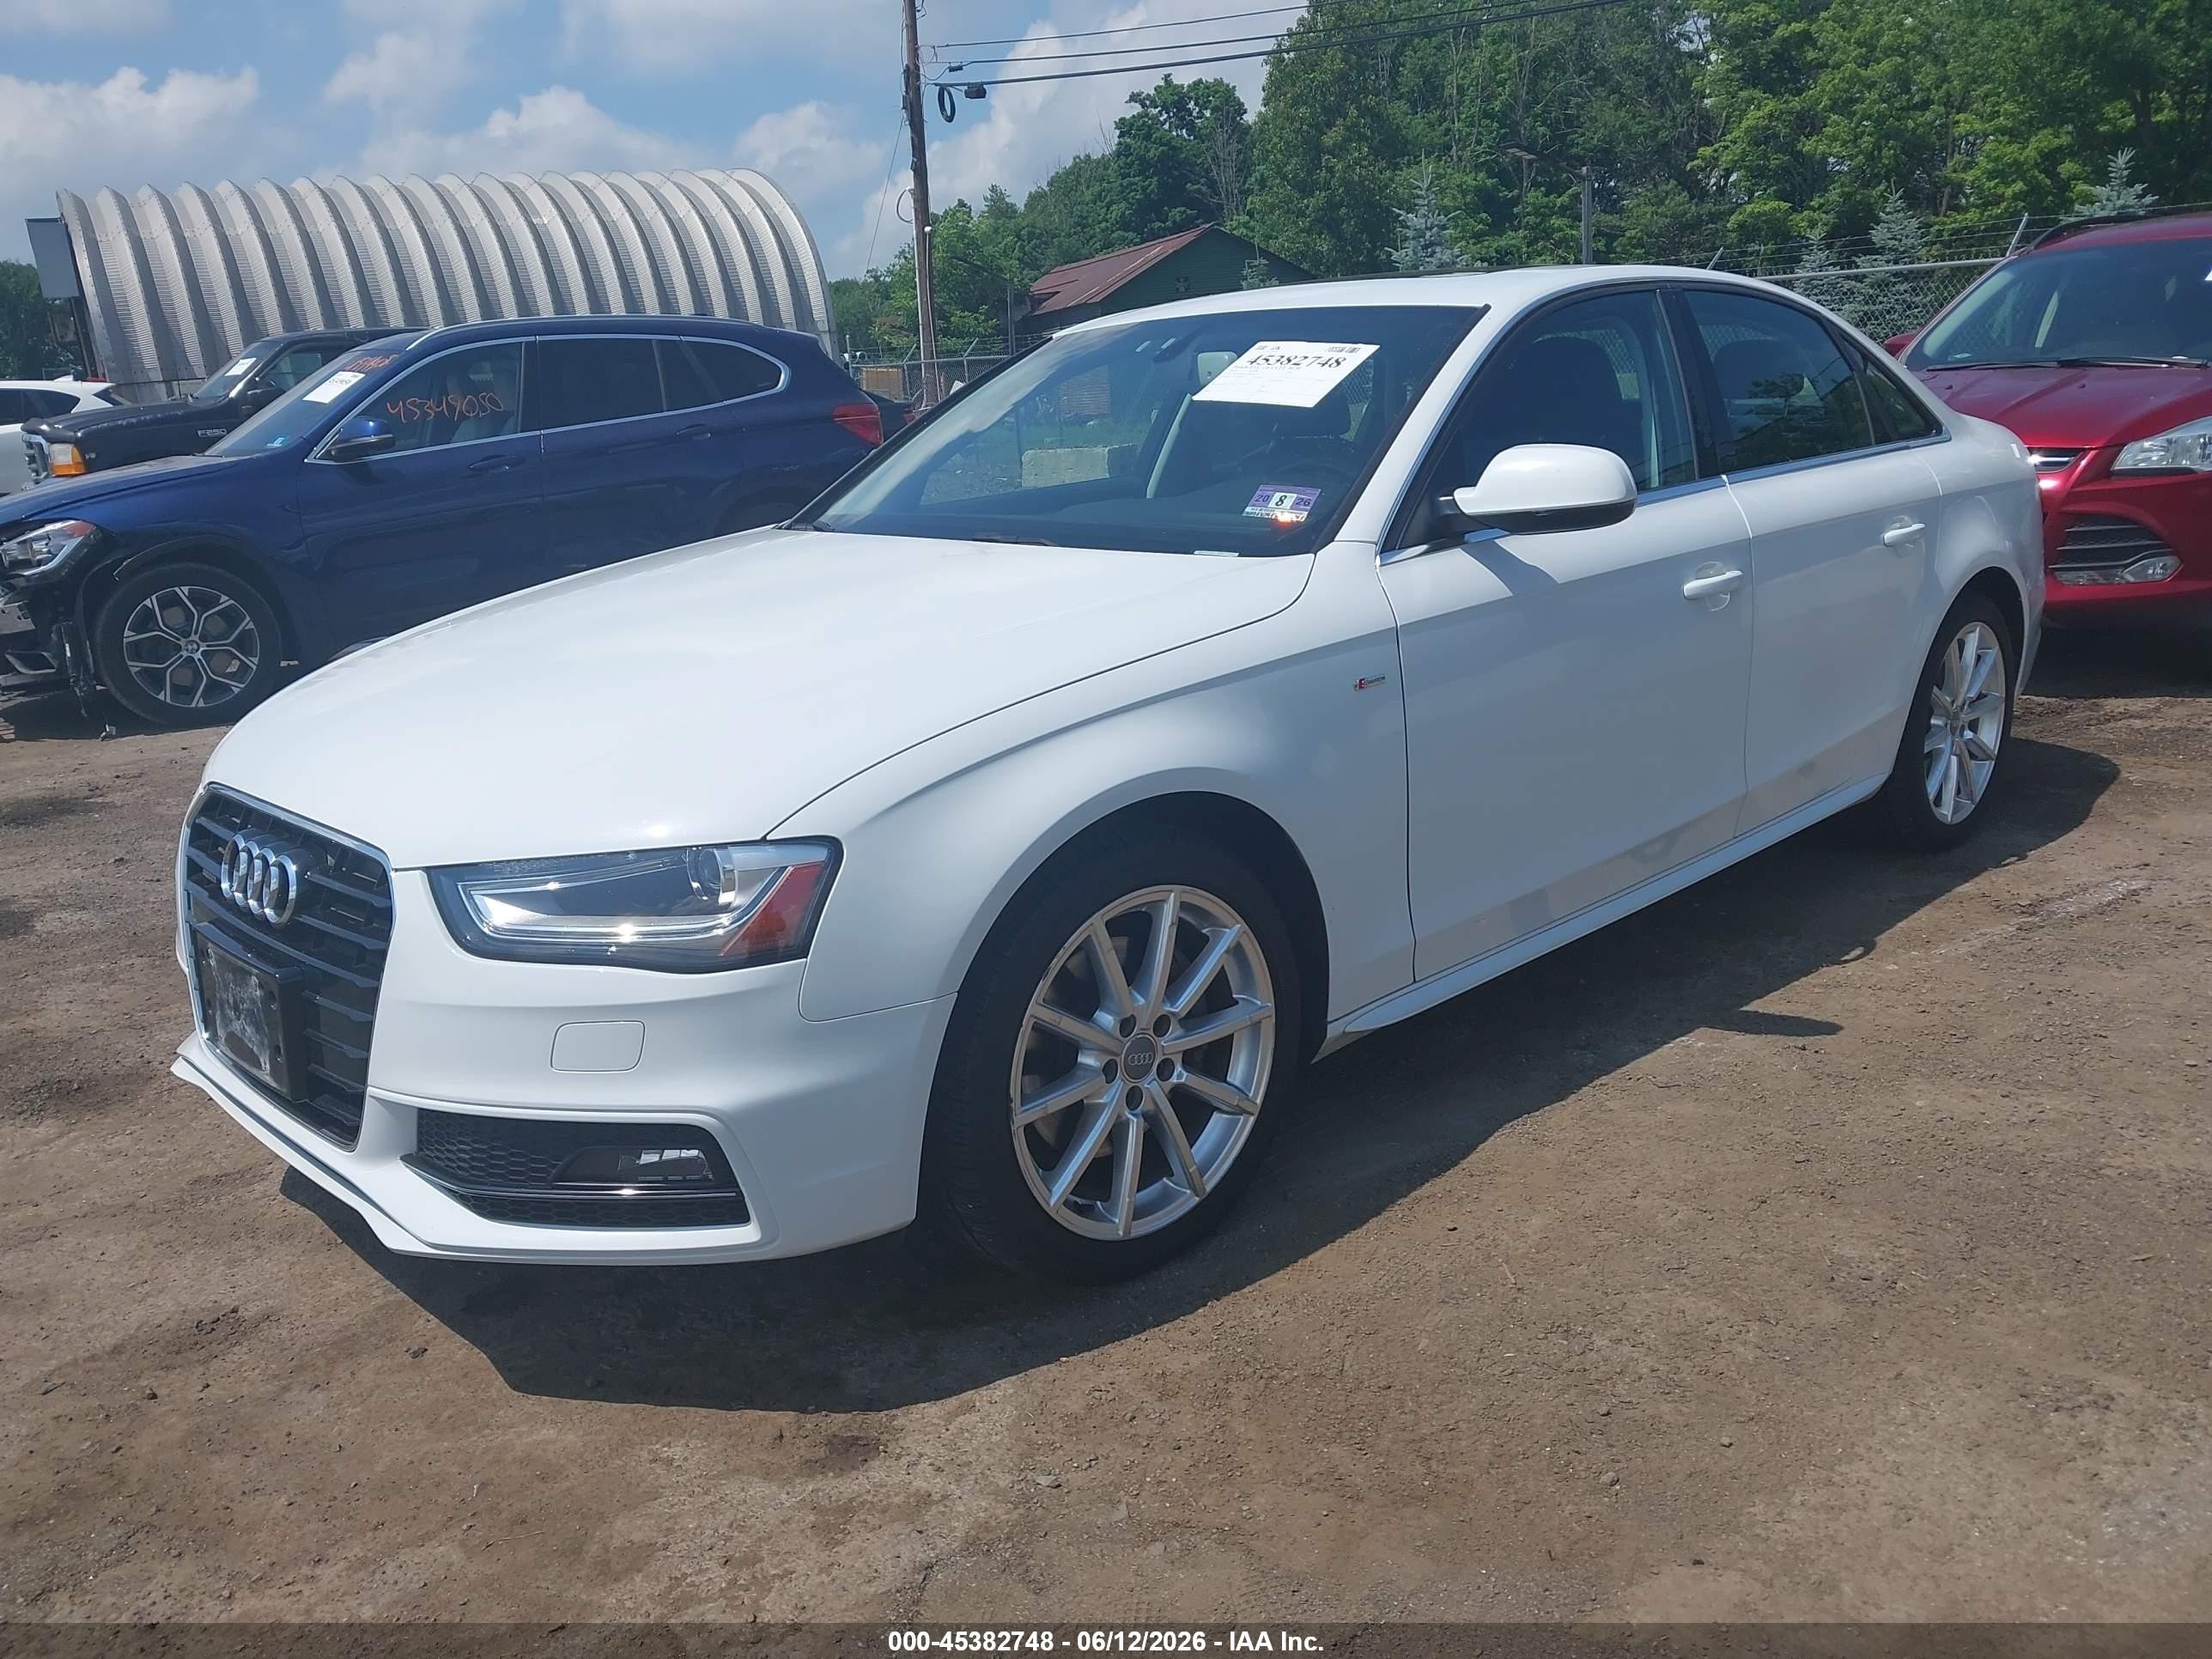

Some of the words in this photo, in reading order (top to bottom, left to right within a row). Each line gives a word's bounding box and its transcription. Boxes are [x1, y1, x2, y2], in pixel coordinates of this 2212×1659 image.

[1246, 354, 1347, 368] 45382748
[386, 392, 504, 424] 45349050
[1275, 495, 1287, 507] 8
[1296, 498, 1311, 507] 26
